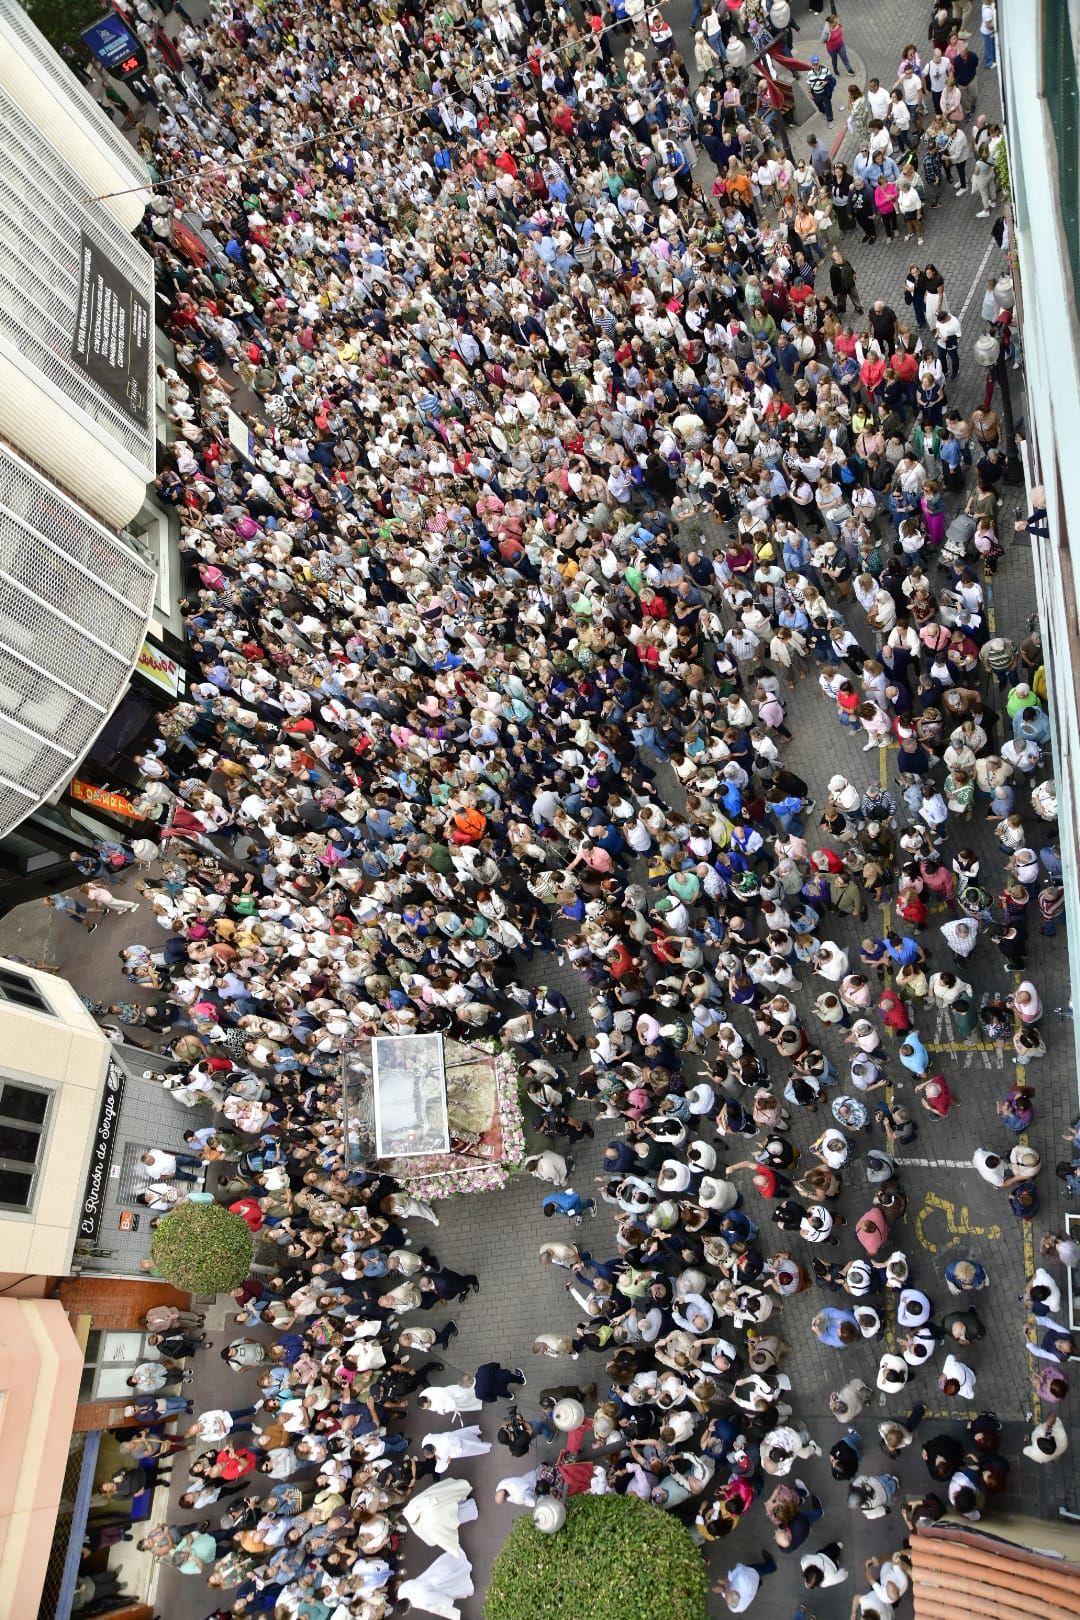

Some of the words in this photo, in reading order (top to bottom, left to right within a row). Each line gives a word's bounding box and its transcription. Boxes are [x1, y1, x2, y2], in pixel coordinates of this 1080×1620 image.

[99, 1094, 117, 1140] Sergio
[96, 1142, 107, 1160] de
[85, 1163, 103, 1214] Rincón
[82, 1216, 94, 1233] El
